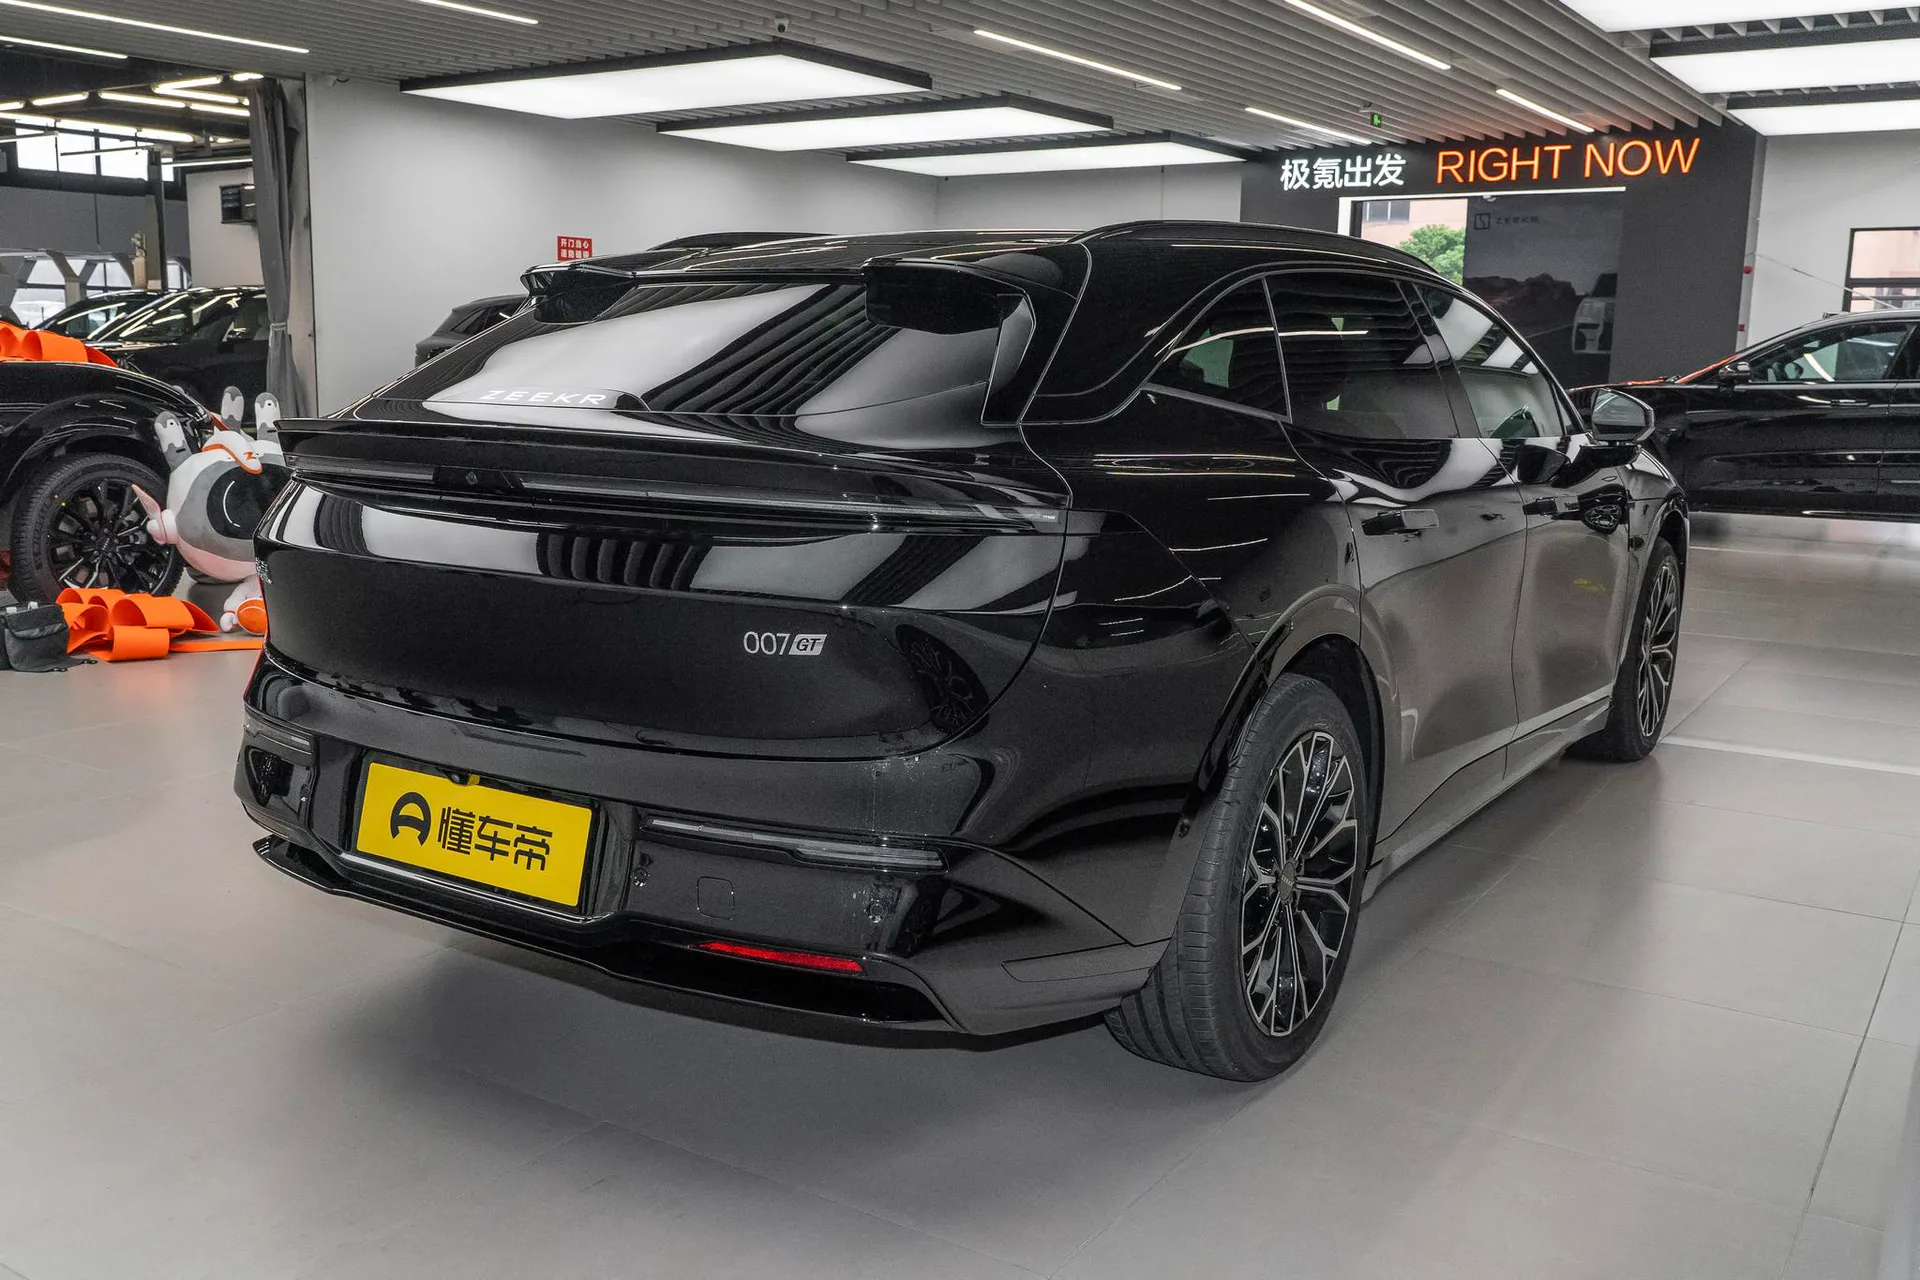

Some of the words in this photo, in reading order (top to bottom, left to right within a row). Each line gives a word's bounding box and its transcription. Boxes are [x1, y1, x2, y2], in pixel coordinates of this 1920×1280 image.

[1280, 153, 1407, 191] 极氪出发
[1436, 144, 1572, 184] RIGHT
[1583, 137, 1700, 178] NOW
[477, 390, 607, 405] ZEEKR
[743, 631, 791, 656] 007
[795, 636, 823, 653] GT
[437, 806, 553, 872] 懂车帝
